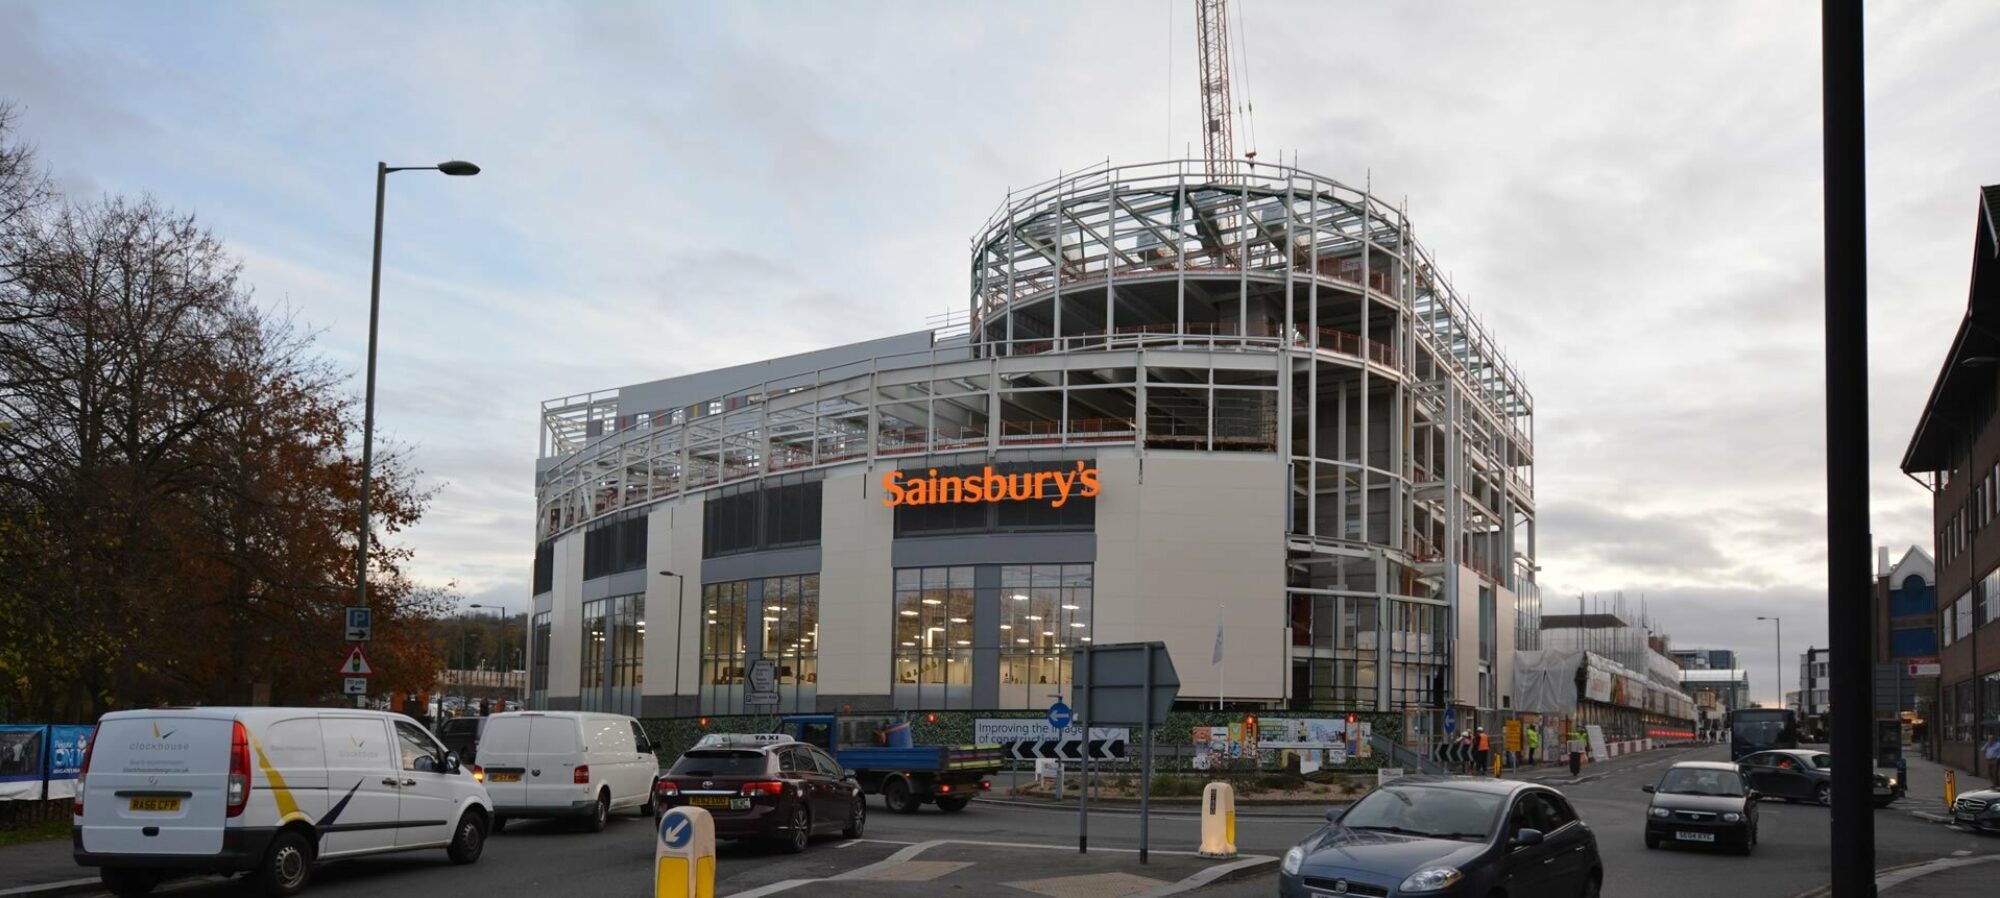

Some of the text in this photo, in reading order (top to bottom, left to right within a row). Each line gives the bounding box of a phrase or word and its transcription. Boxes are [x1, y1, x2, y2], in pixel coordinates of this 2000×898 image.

[881, 459, 1102, 508] Sainsbury's
[353, 611, 366, 627] P
[978, 723, 1030, 736] Improving
[1032, 723, 1049, 733] the
[978, 733, 1060, 744] of construction
[128, 742, 190, 751] clockhouse
